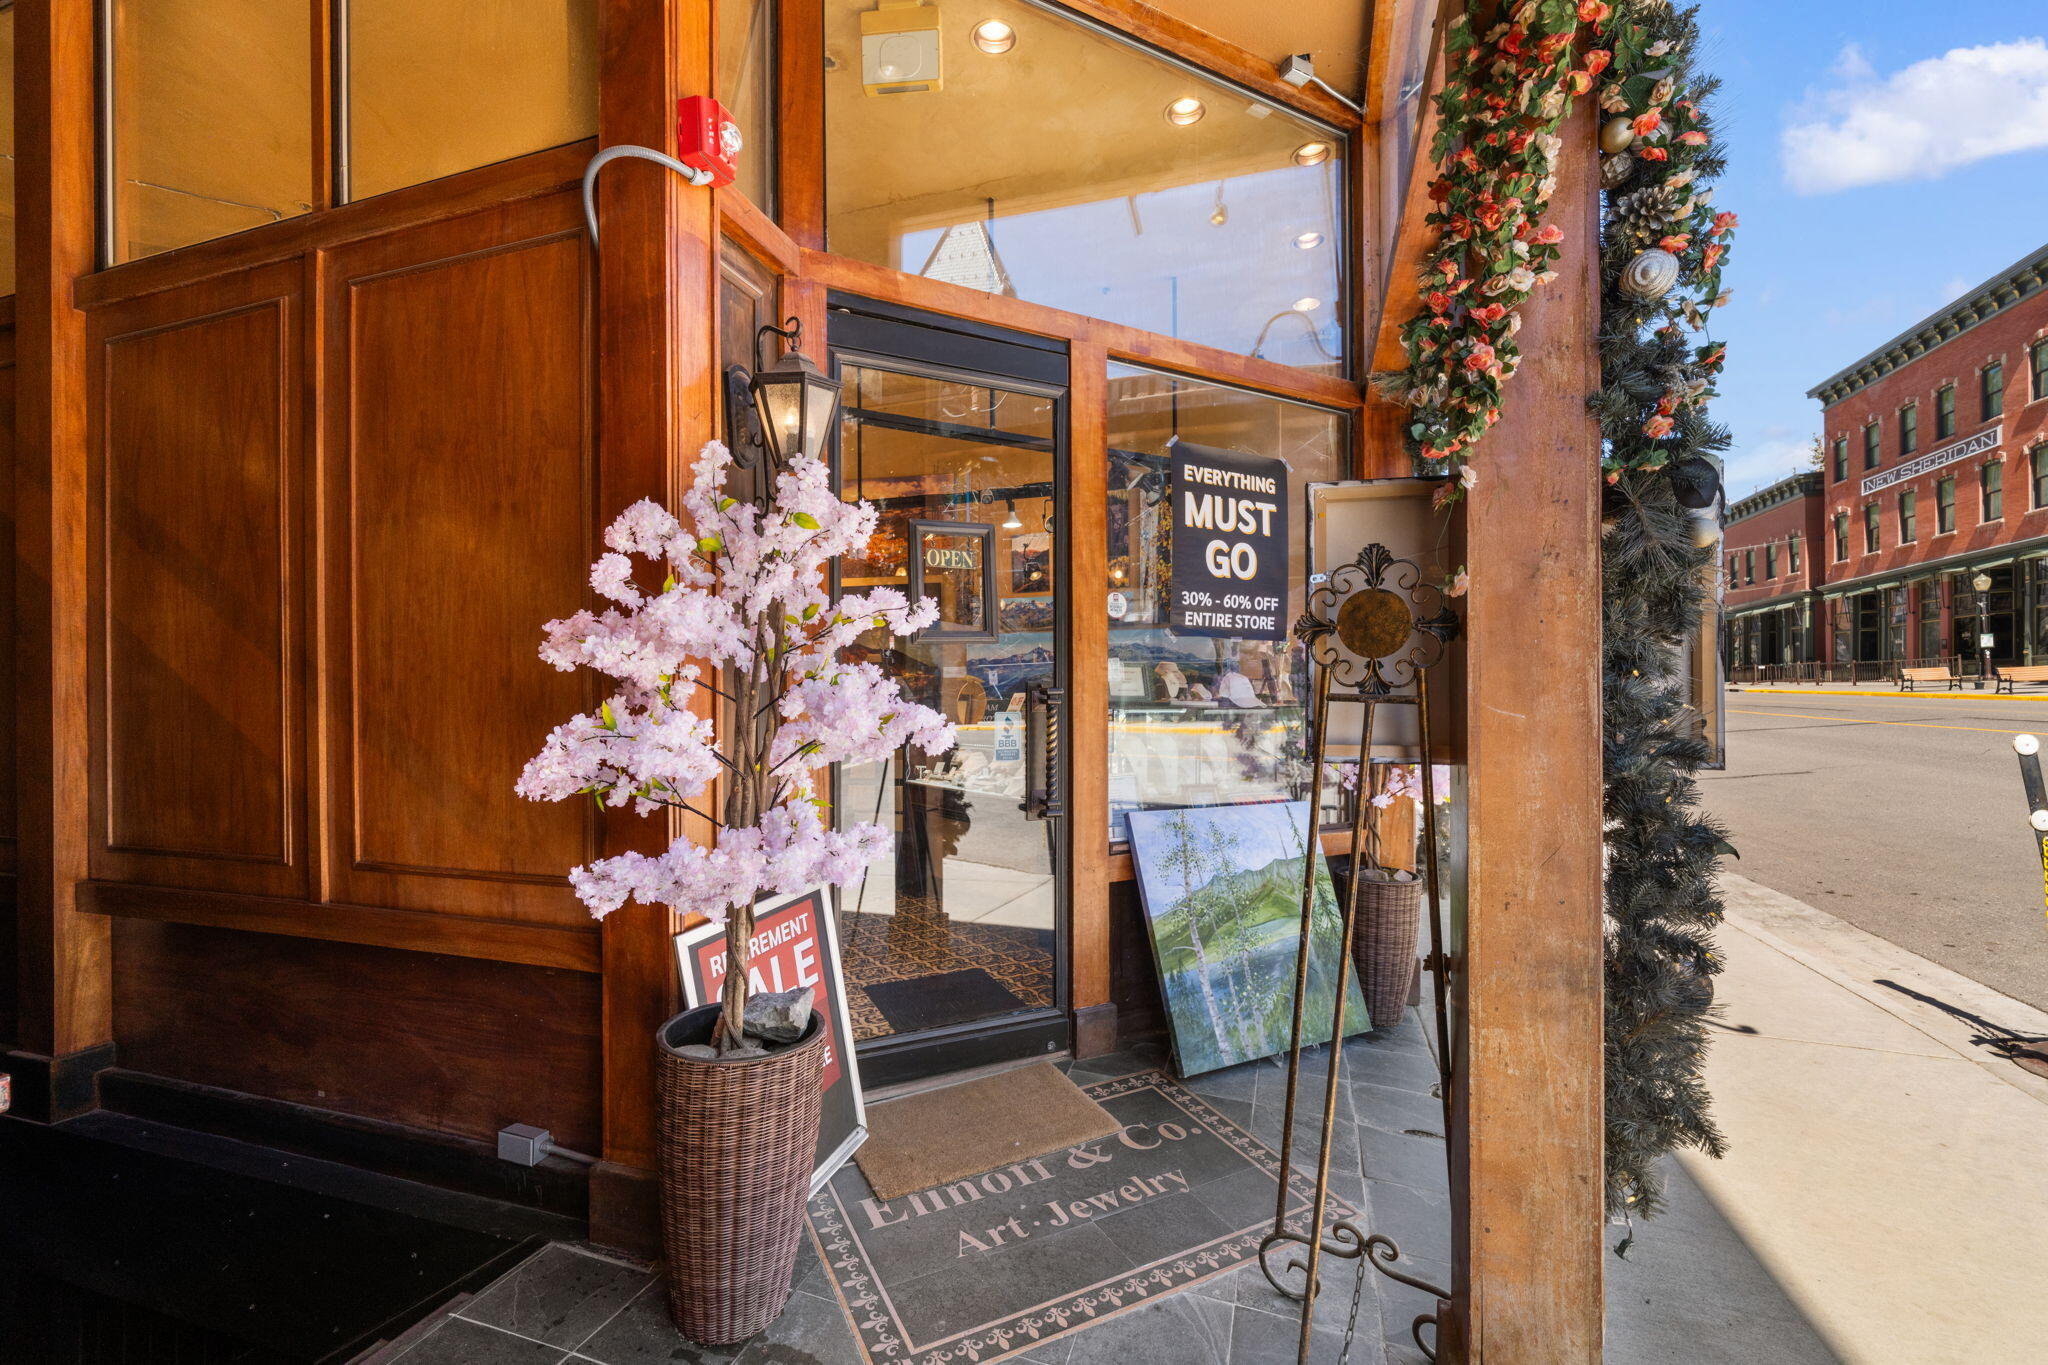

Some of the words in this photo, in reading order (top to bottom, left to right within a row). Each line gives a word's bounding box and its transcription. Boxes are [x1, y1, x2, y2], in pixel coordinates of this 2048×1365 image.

[1184, 464, 1276, 495] EVERYTHING
[1865, 471, 1897, 492] NEW
[1184, 491, 1277, 537] MUST
[926, 549, 974, 568] OPEN
[1206, 539, 1258, 581] GO
[1181, 591, 1212, 607] 30%
[1223, 594, 1252, 610] 60%
[1254, 597, 1279, 611] OFF
[1184, 611, 1233, 628] ENTIRE
[1235, 614, 1275, 630] STORE
[998, 739, 1017, 748] BBB
[716, 936, 819, 1002] ALE
[1067, 1142, 1113, 1169] &
[1118, 1122, 1202, 1150] Co.
[957, 1216, 1030, 1258] Art
[1043, 1169, 1190, 1227] Jewelry
